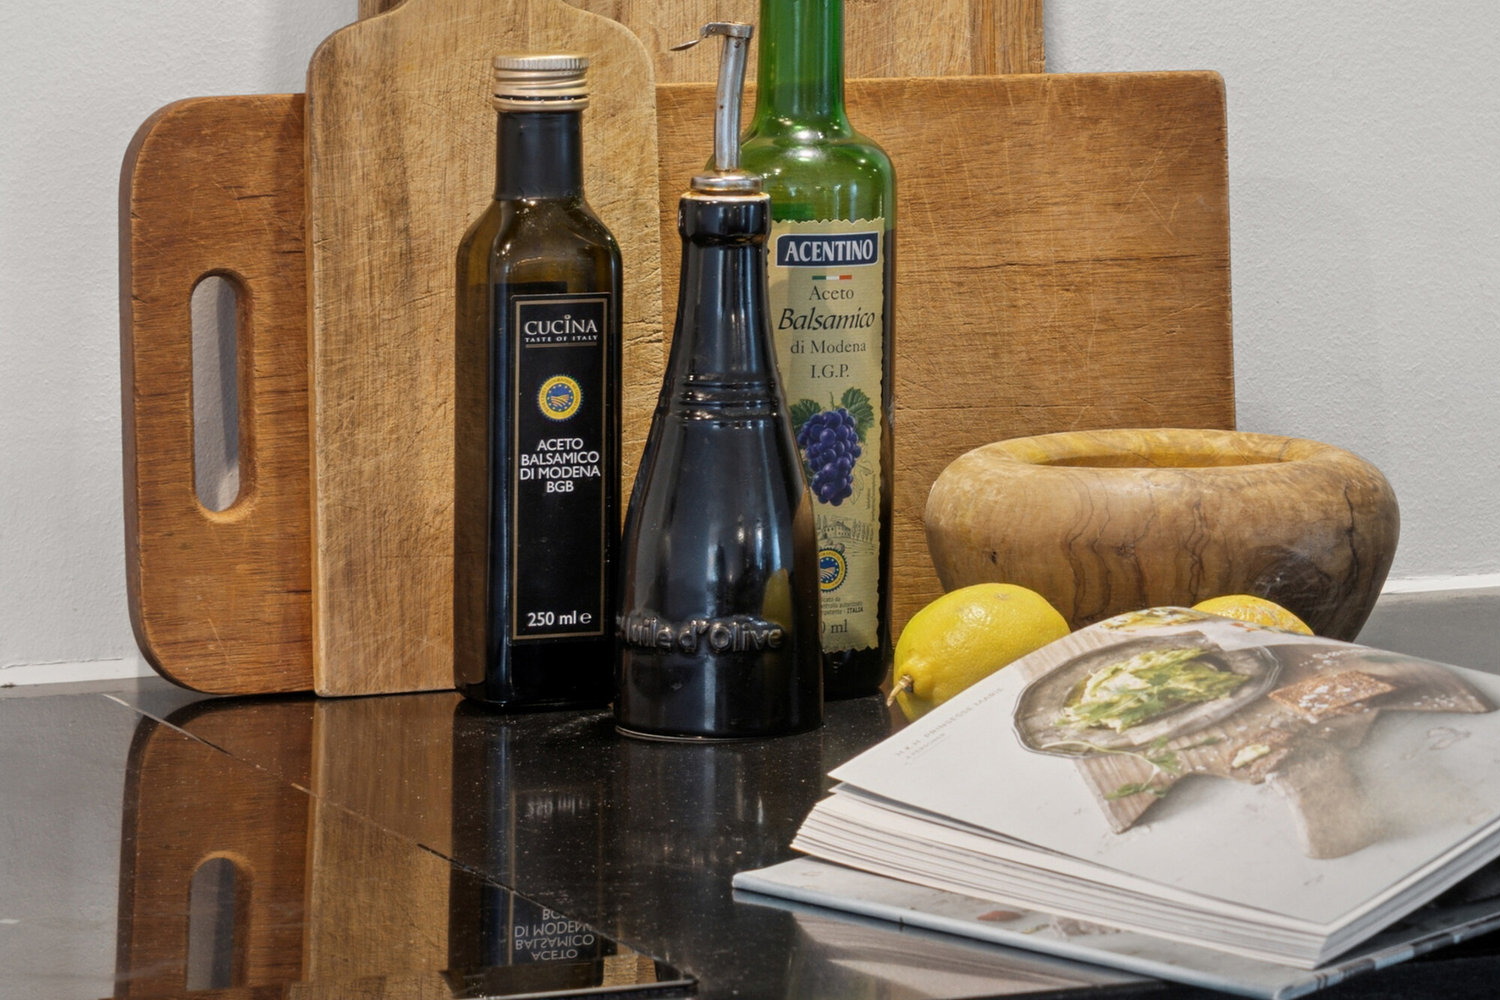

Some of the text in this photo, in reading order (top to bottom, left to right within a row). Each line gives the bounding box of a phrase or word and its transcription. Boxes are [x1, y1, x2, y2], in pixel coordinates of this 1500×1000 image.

[785, 239, 873, 262] ACENTINO
[809, 285, 854, 300] Aceto
[777, 306, 875, 330] Balsamico
[790, 340, 866, 354] di Modena
[810, 364, 850, 379] I.G.P.
[536, 438, 584, 452] ACETO
[521, 450, 599, 466] BALSAMICO
[520, 465, 601, 481] DI MODENA
[546, 480, 574, 493] BGB
[846, 606, 864, 614] ITALIA
[527, 611, 555, 627] 250
[559, 610, 577, 625] ml
[831, 618, 848, 634] ml
